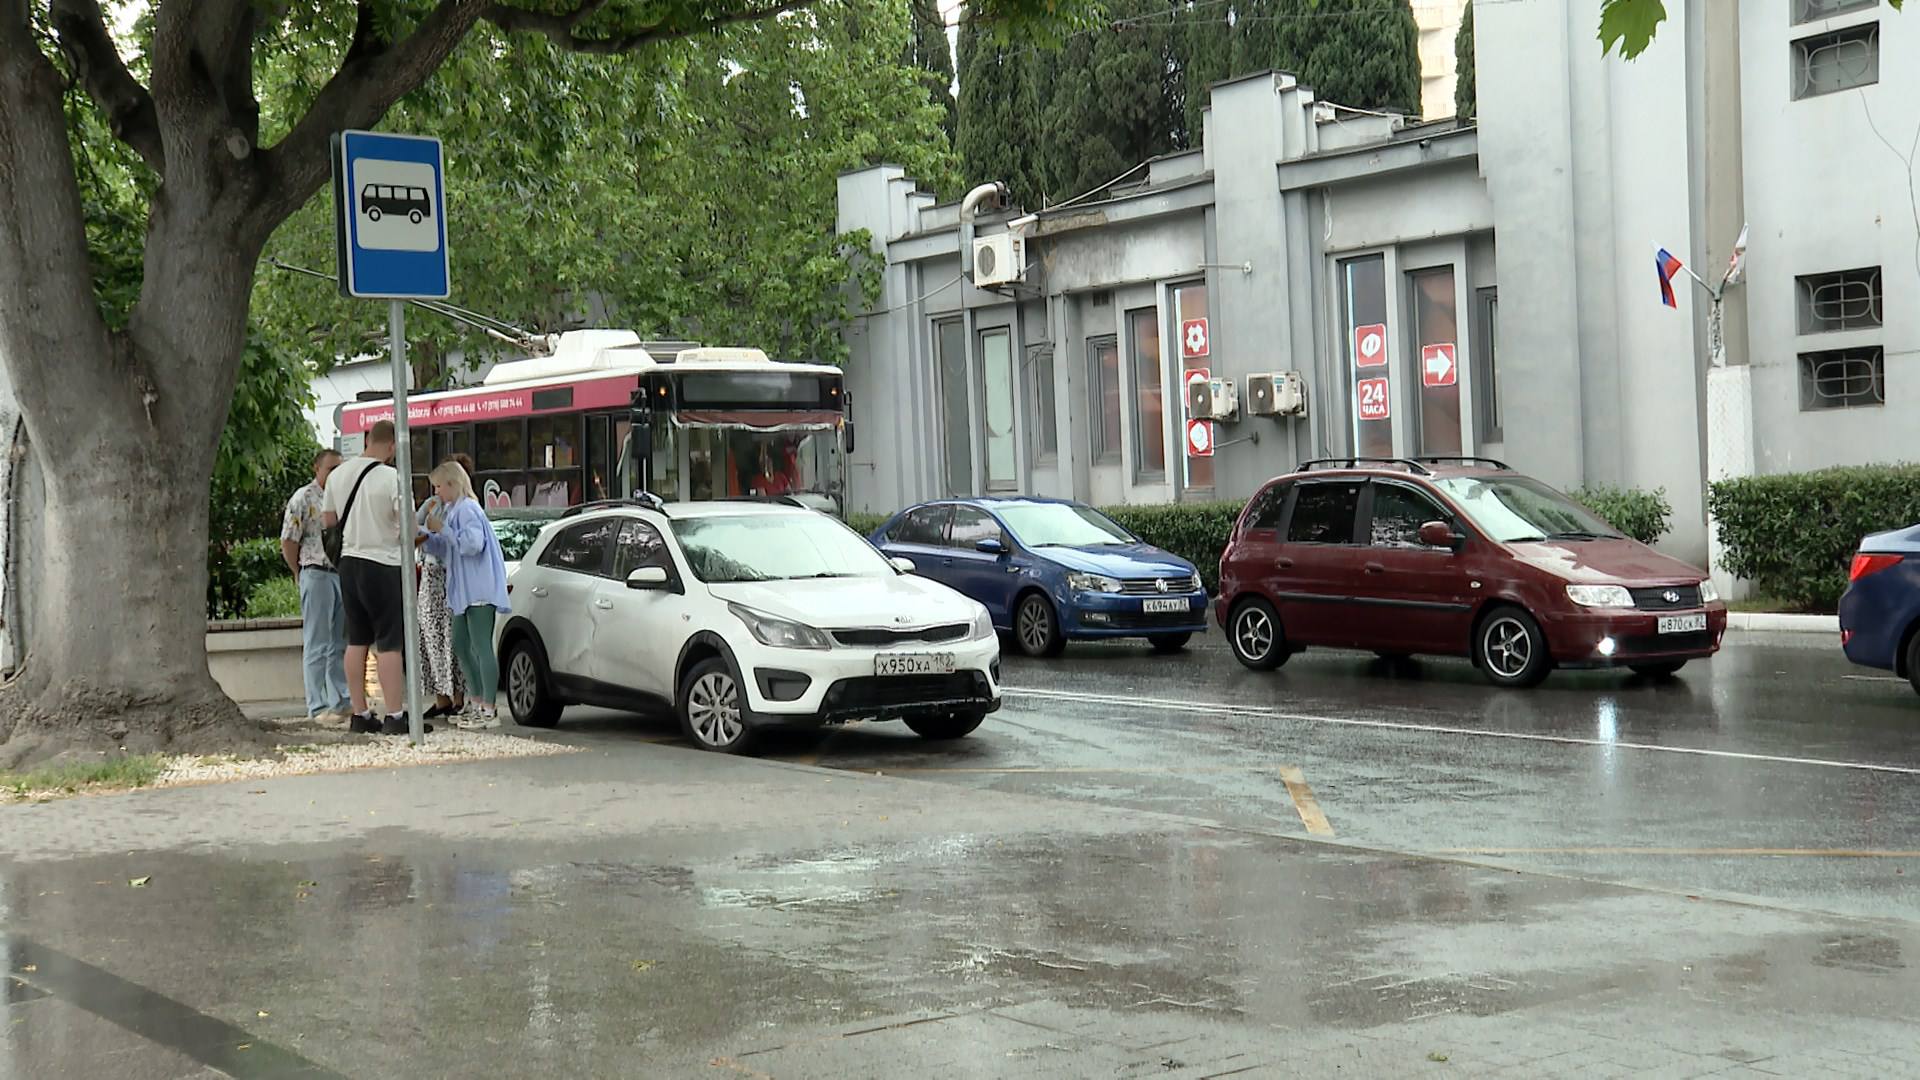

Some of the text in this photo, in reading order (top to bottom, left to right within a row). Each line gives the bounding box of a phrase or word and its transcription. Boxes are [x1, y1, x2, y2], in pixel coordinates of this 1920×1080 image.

[1363, 383, 1385, 404] 24
[1363, 403, 1386, 416] ЧАСА
[1661, 618, 1694, 632] Н870СК
[880, 657, 930, 674] Х950ХА
